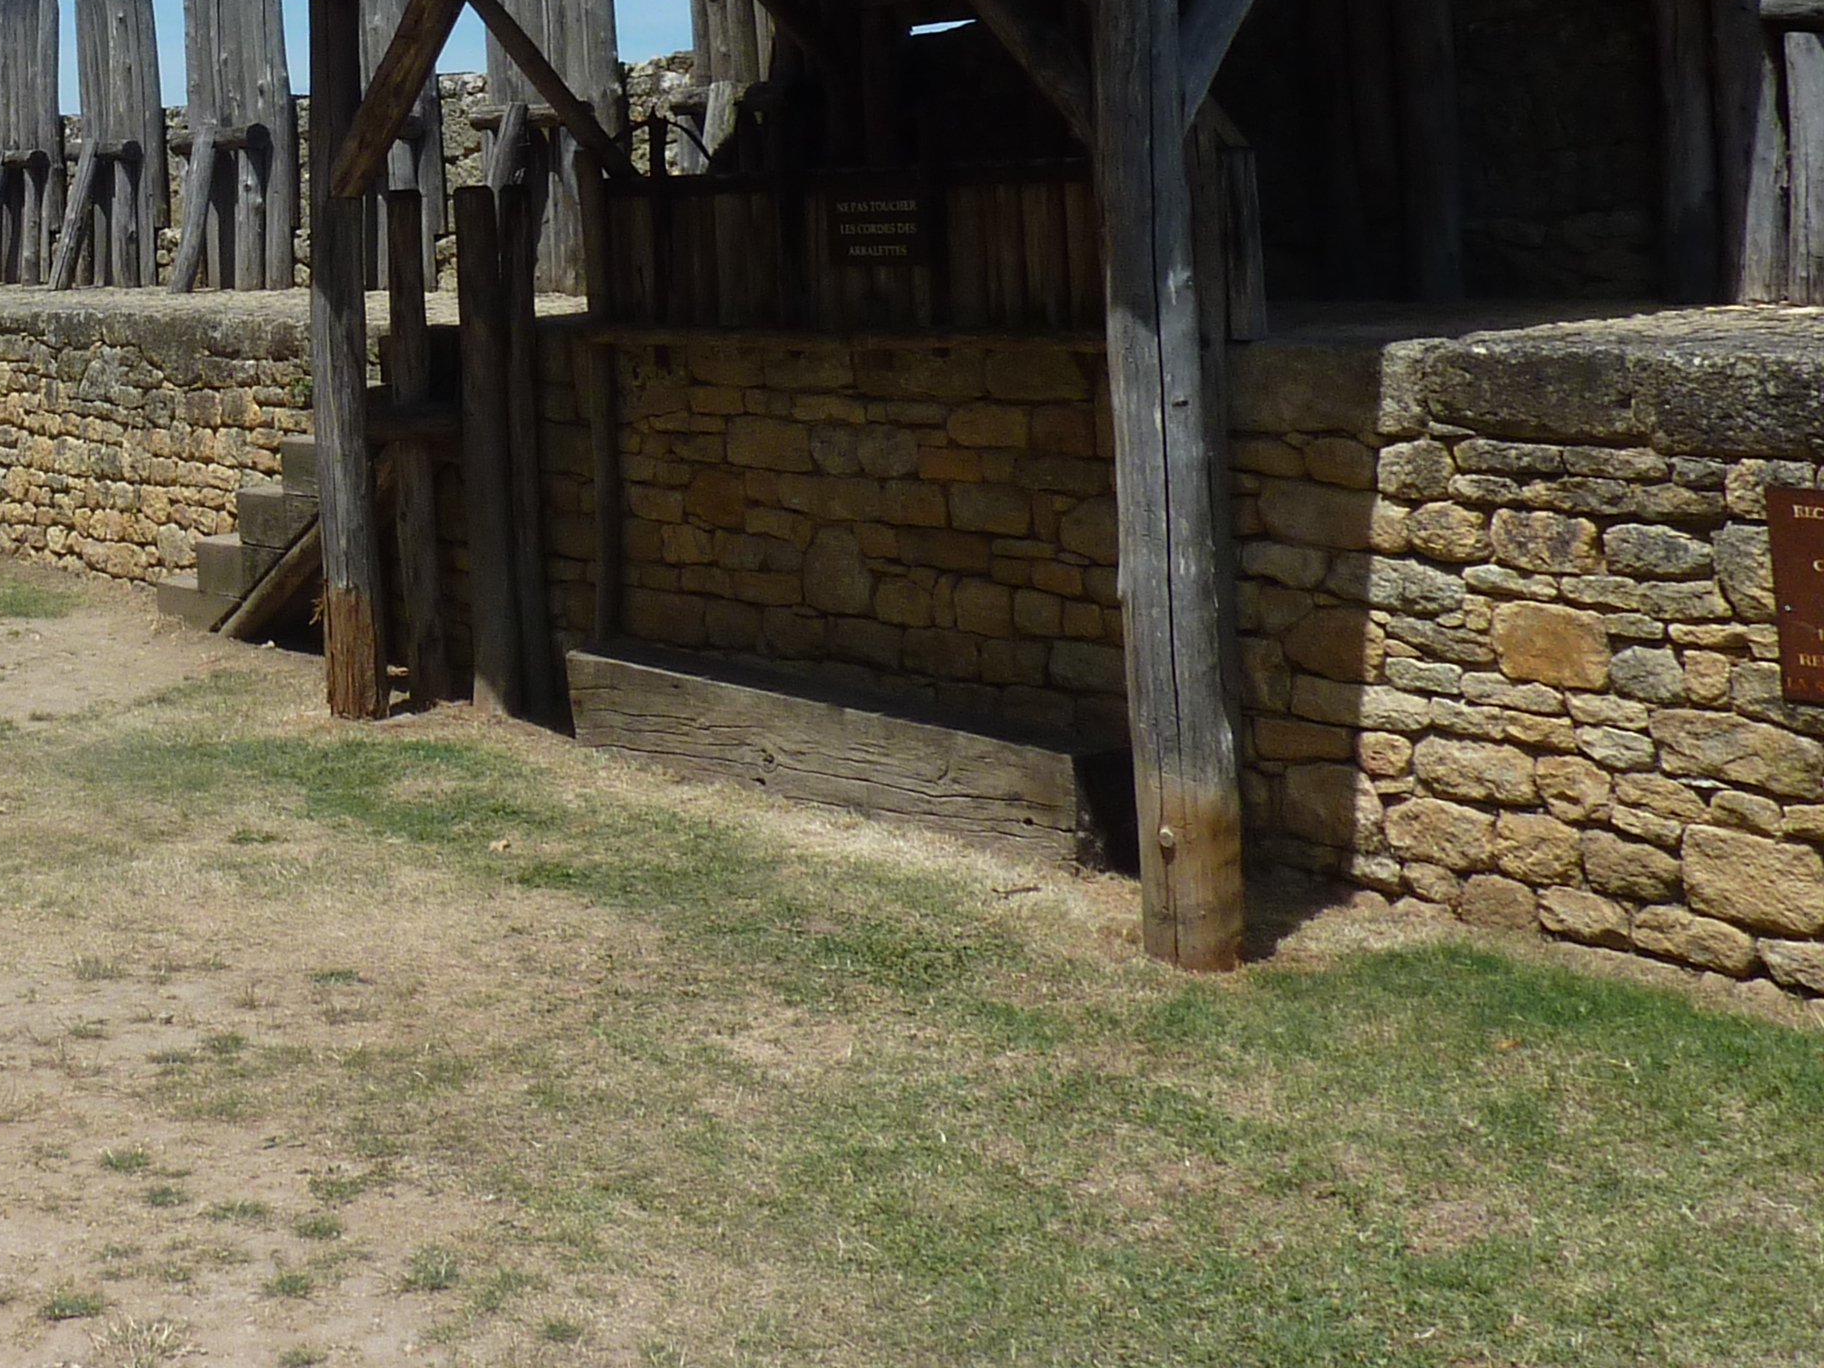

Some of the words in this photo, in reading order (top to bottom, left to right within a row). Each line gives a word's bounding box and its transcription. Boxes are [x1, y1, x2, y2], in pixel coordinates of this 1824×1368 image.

[836, 201, 849, 212] NE
[851, 201, 868, 212] PAS
[870, 199, 917, 212] TOUCHER
[840, 223, 856, 234] LES
[857, 223, 895, 234] CORDES
[897, 222, 917, 234] DES
